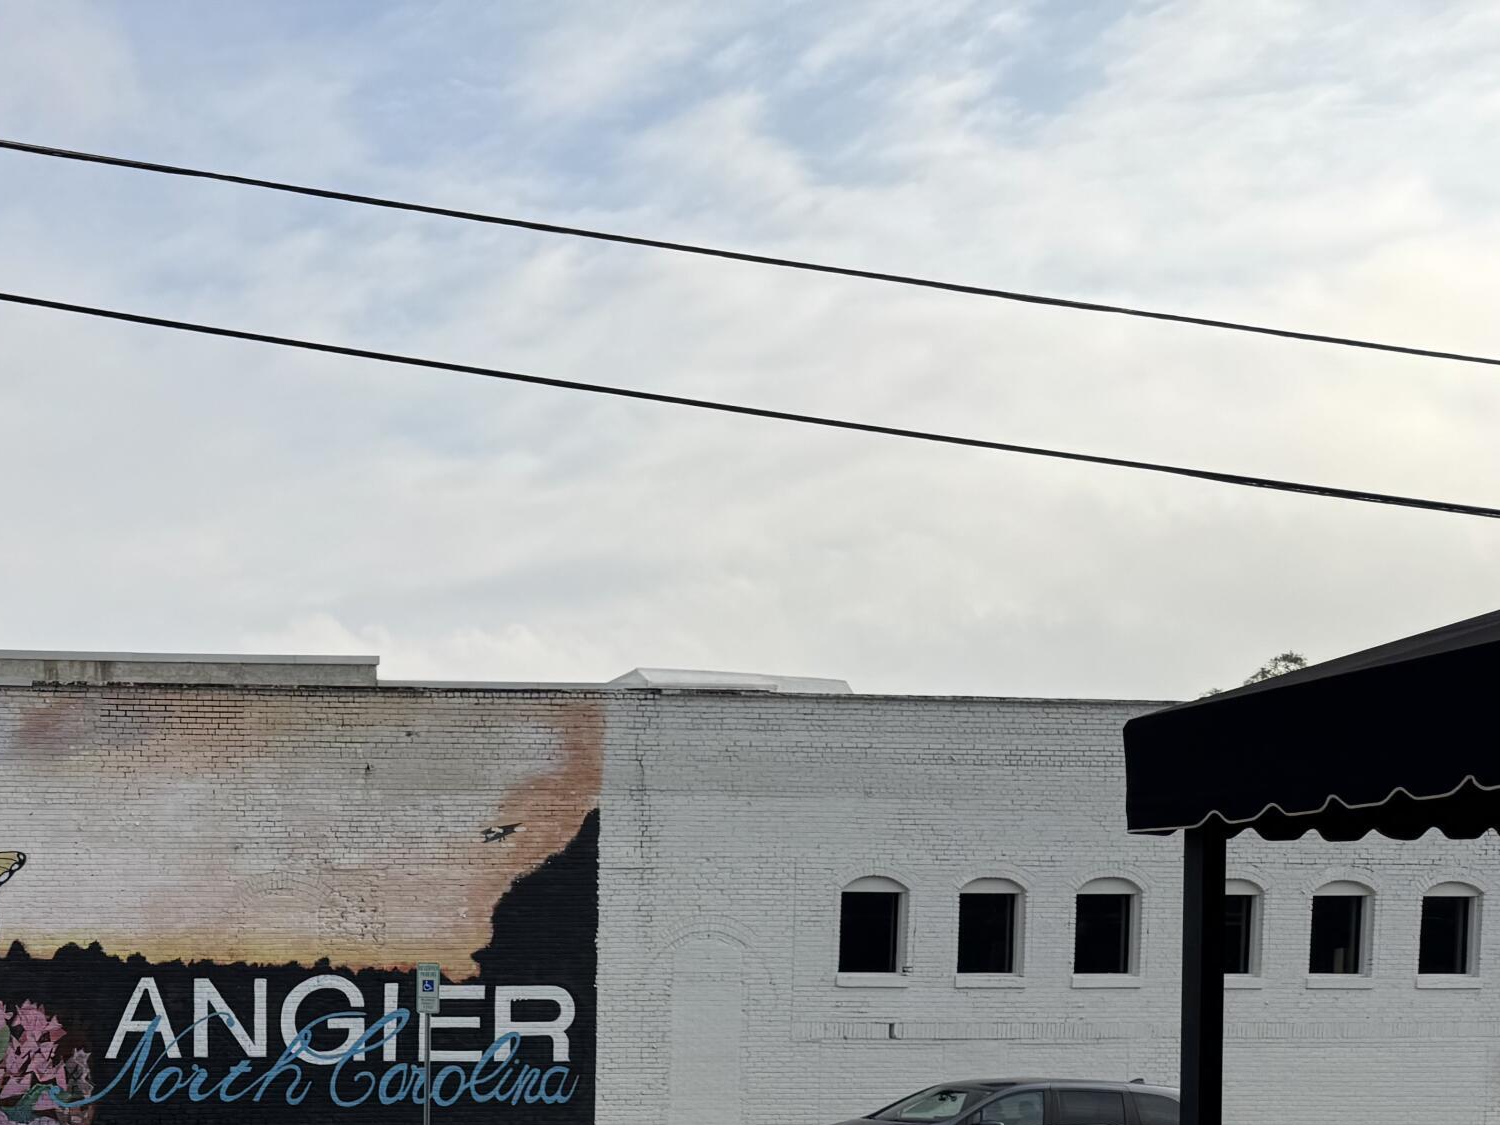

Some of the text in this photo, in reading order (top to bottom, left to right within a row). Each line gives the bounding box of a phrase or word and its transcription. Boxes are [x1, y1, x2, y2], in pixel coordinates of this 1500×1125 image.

[51, 1008, 580, 1107] North Carolina
[105, 974, 576, 1065] ANGIER
